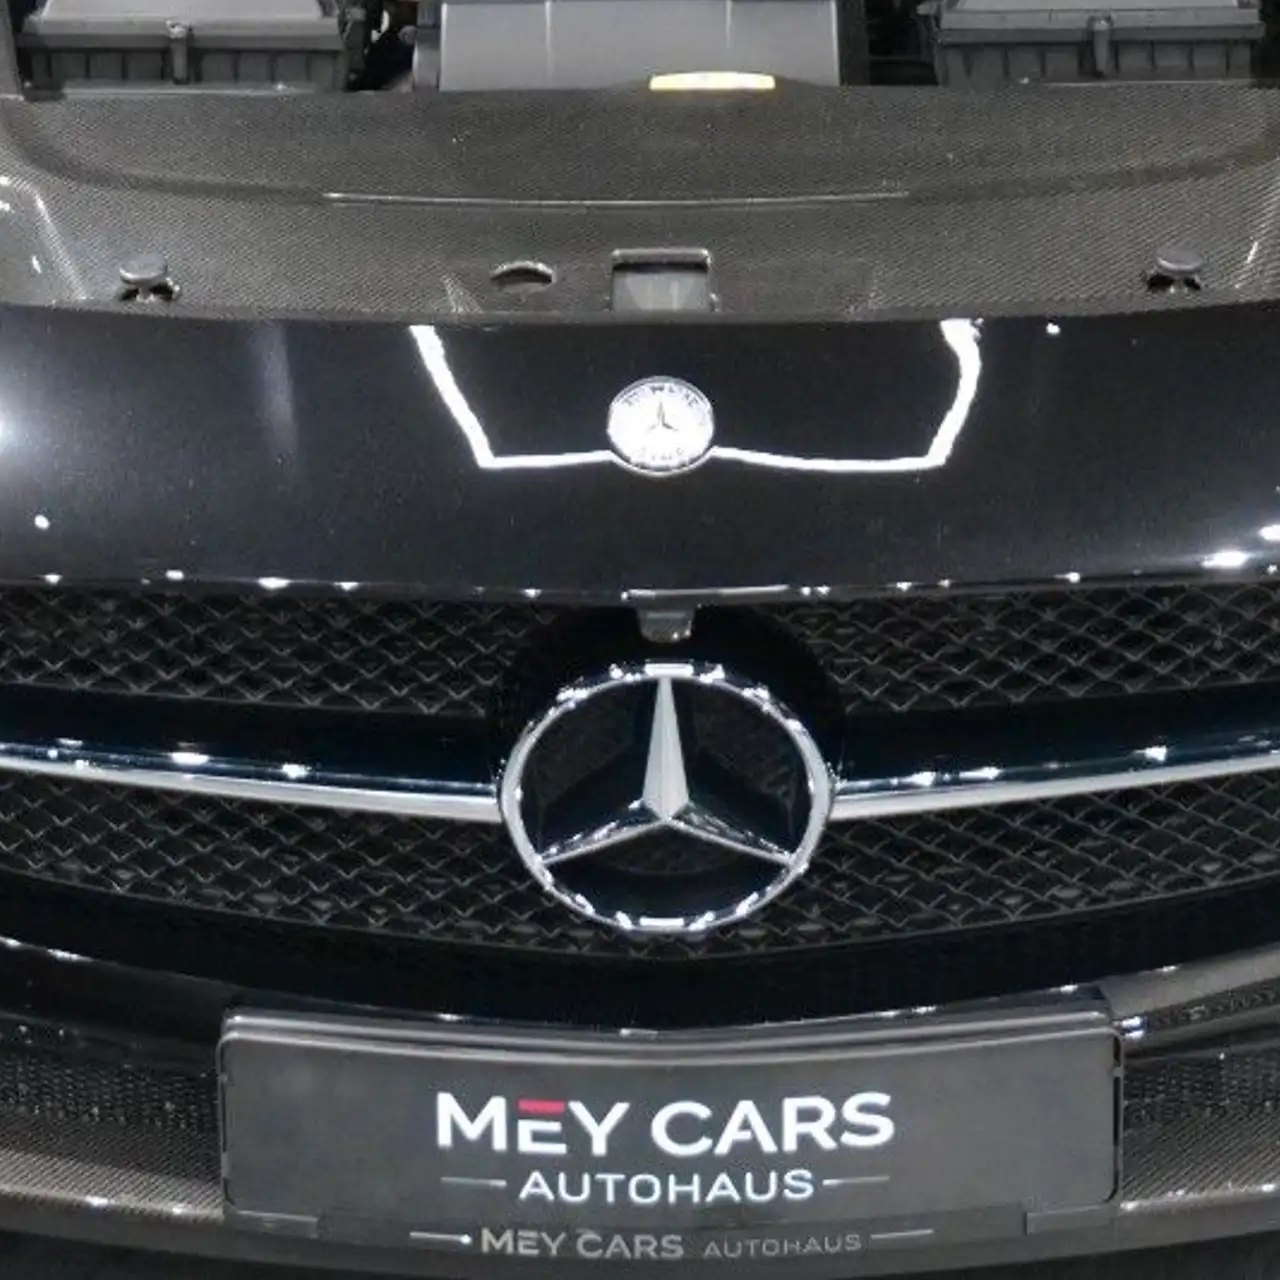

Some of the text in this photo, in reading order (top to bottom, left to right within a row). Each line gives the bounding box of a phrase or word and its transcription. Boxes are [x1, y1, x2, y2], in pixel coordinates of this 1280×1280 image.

[436, 1092, 895, 1156] MEY CARS
[519, 1169, 815, 1204] AUTOHAUS
[481, 1228, 862, 1260] MEY CARS AUTOHAUS
